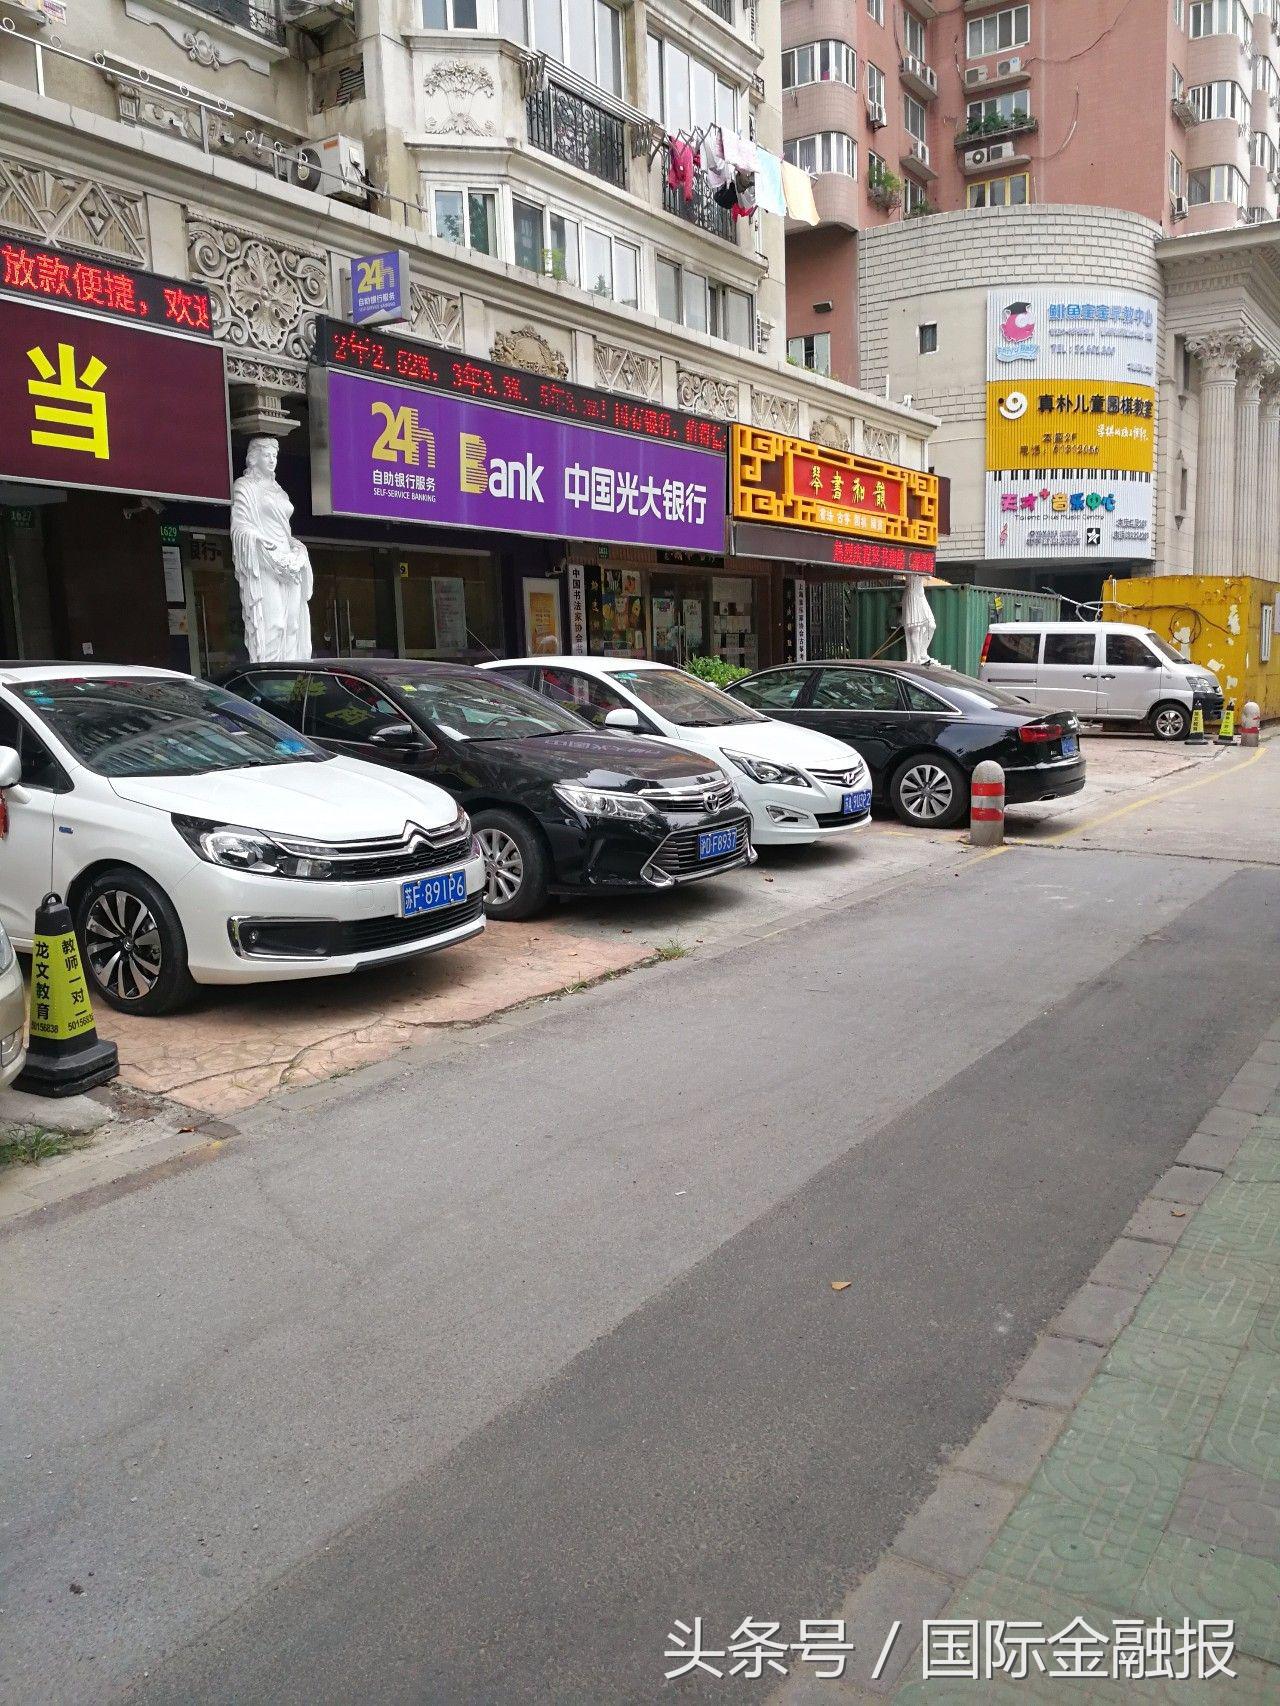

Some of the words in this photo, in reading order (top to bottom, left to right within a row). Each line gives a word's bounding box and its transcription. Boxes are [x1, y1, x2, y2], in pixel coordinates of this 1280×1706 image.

[357, 259, 395, 293] 24h
[27, 343, 110, 459] 当
[371, 401, 436, 468] 24h
[459, 431, 545, 503] Bank
[373, 469, 436, 492] 自助银行服务
[373, 488, 410, 500] SELF-SERVICE
[411, 492, 436, 503] BANKING
[564, 462, 707, 525] 中国光大银行
[160, 526, 177, 537] 1629
[35, 941, 50, 1020] 龙文教育
[61, 938, 87, 1016] 教师一对一
